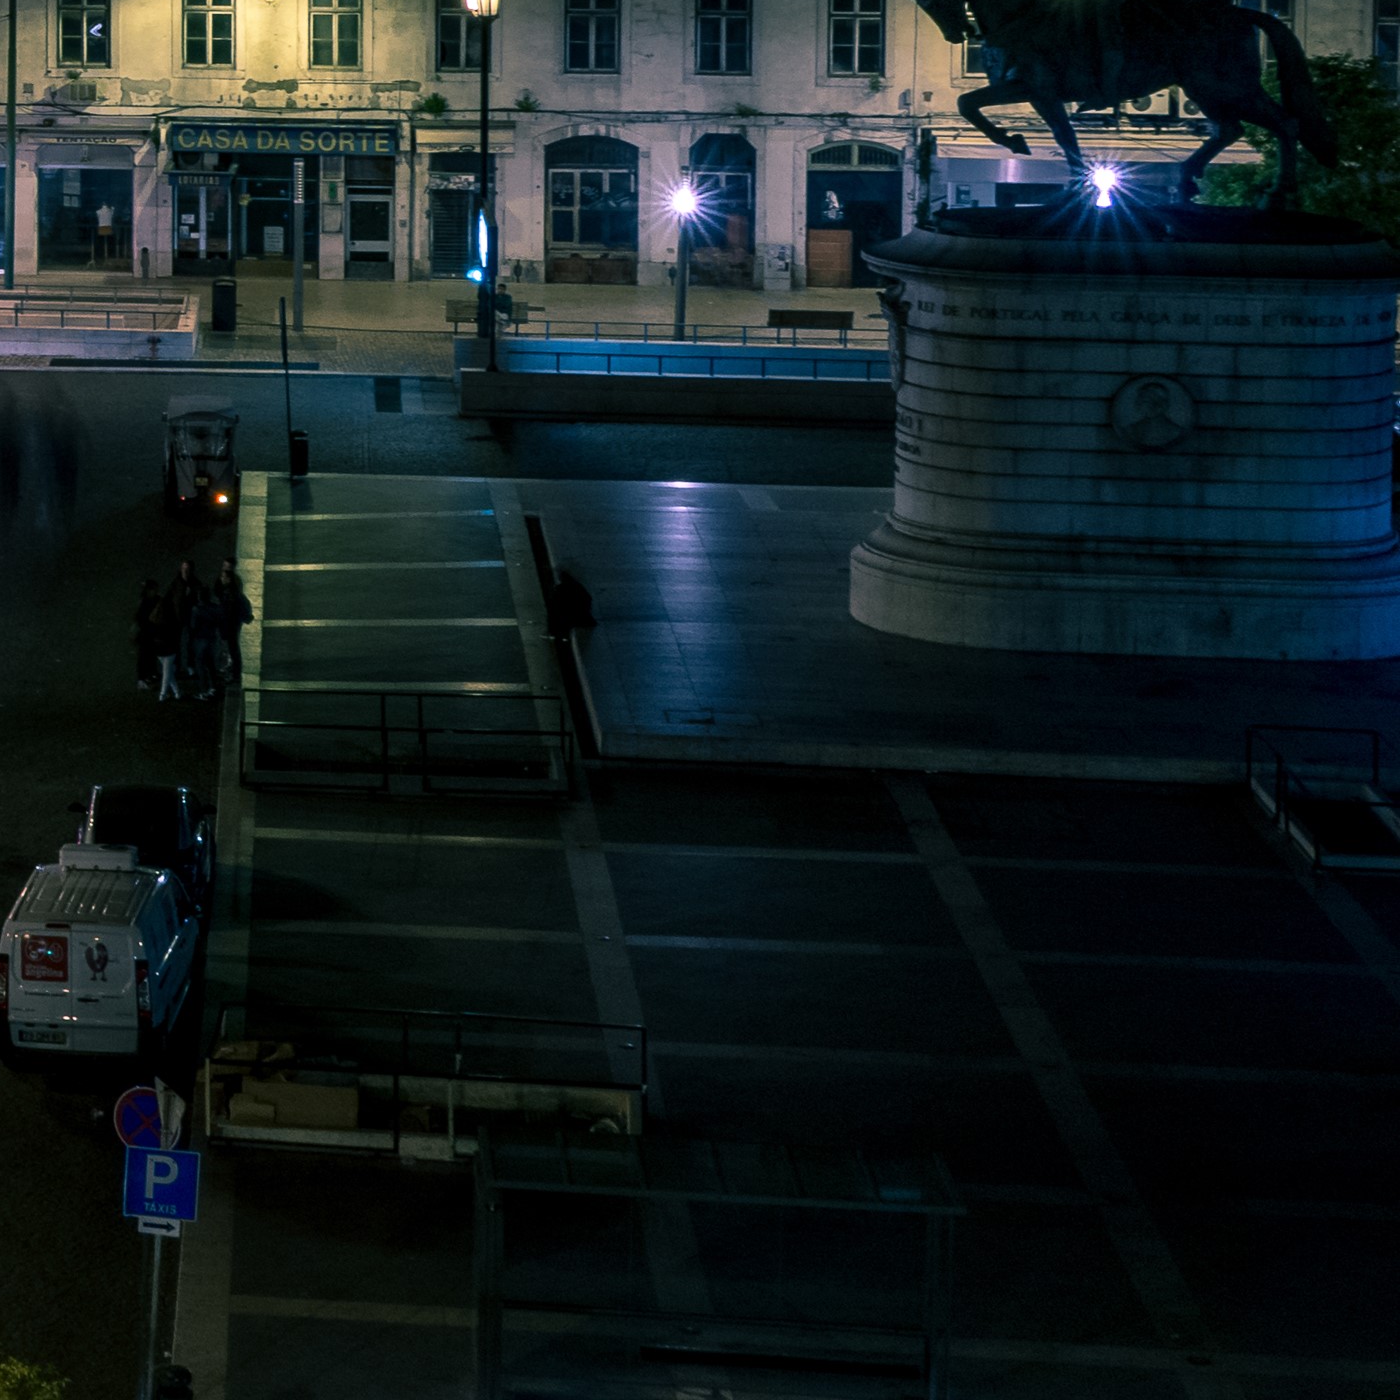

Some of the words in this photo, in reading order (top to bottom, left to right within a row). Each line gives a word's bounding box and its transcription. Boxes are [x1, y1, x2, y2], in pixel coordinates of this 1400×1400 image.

[177, 128, 249, 150] CASA
[256, 129, 292, 151] DA
[299, 131, 391, 153] SORTE
[178, 175, 220, 185] LOTARIAS
[970, 306, 1052, 322] PORTUGAL
[145, 1153, 179, 1200] P
